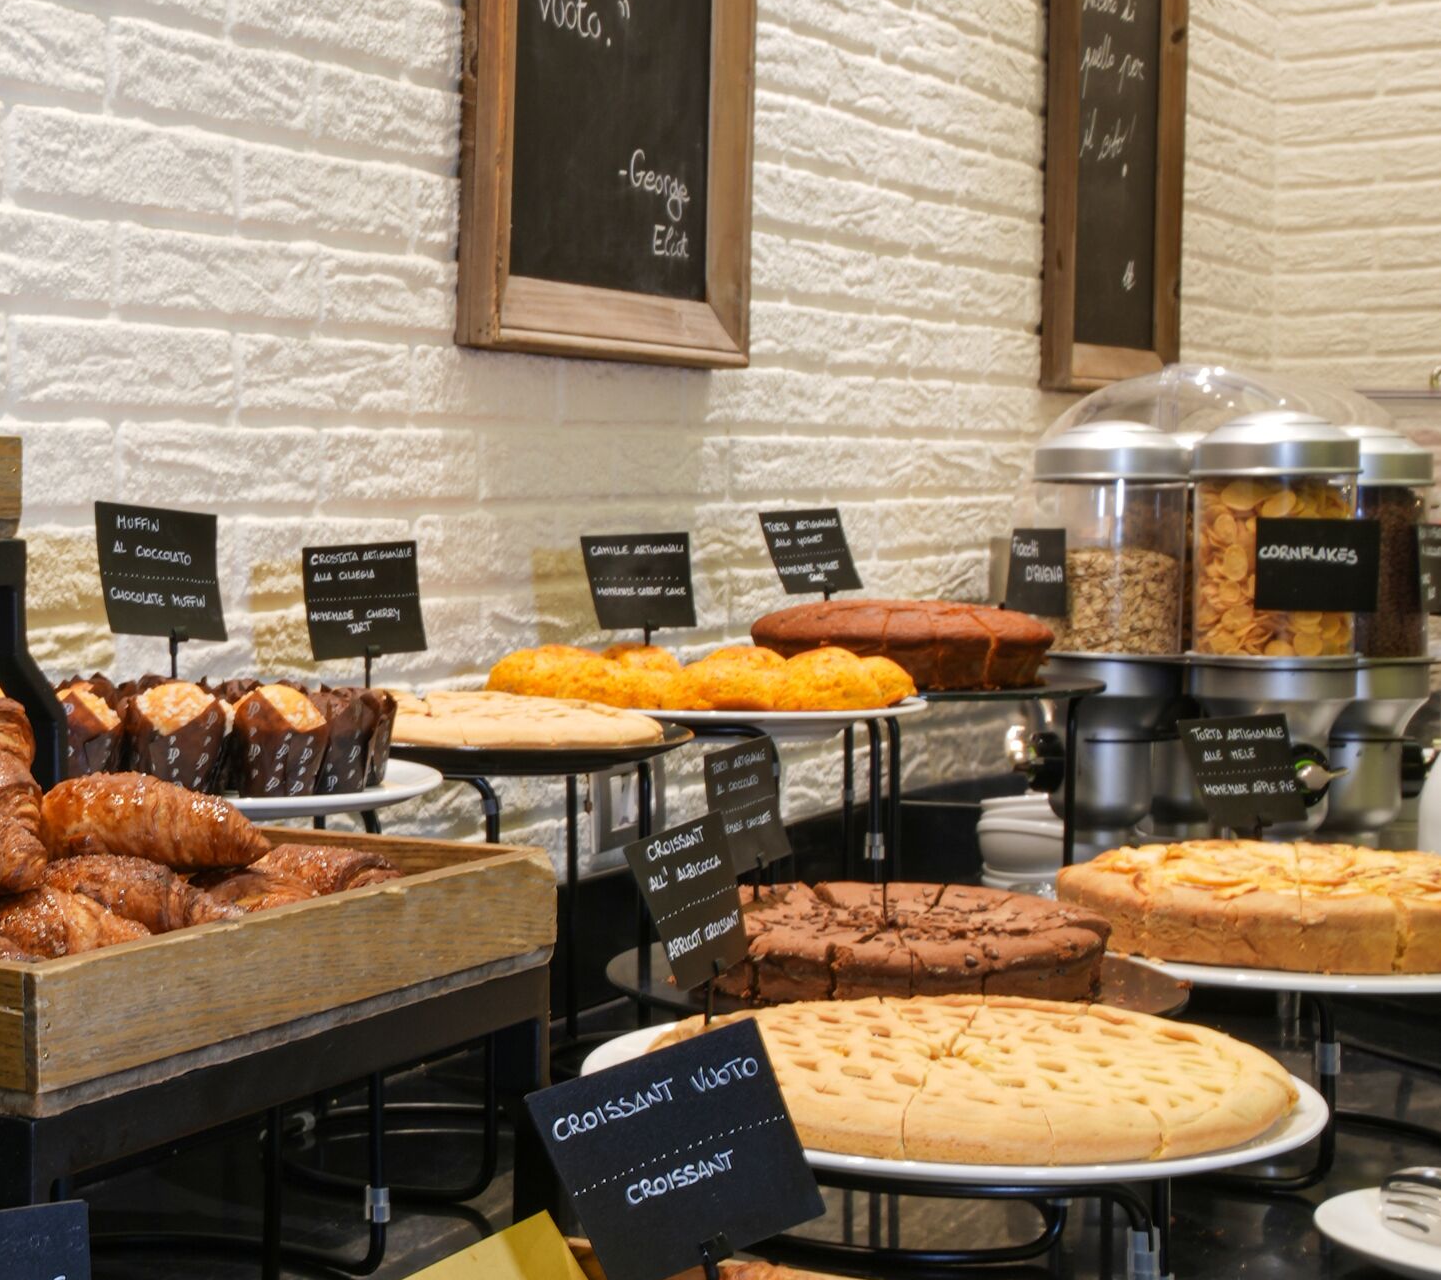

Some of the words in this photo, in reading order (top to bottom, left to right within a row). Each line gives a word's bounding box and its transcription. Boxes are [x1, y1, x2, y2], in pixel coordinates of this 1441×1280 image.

[652, 223, 690, 259] Eliot
[116, 514, 160, 533] MUFFIN
[113, 540, 127, 553] AL
[135, 545, 192, 567] CIOCCOLATO
[310, 550, 359, 566] CROSTATA
[362, 546, 413, 562] ARTIGIANALE
[590, 544, 630, 557] CAMILLE
[1259, 543, 1359, 566] CORNFLAKES
[313, 571, 333, 583] ALLA
[110, 586, 166, 608] CHOCOLATE
[171, 593, 206, 609] MUFFIN
[310, 609, 355, 622] HOMEMADE
[365, 607, 401, 621] CHERRY
[346, 620, 372, 635] TART
[1190, 726, 1224, 741] TORTA
[1202, 749, 1224, 762] ALLE
[1230, 747, 1257, 761] MELE
[1252, 780, 1278, 794] APPLE
[1279, 780, 1297, 793] PIE
[646, 824, 705, 862] CROISSANT
[676, 854, 722, 882] ALBICOCCA
[666, 927, 703, 961] APRICOT
[703, 908, 740, 941] CROISSANT
[551, 1077, 674, 1143] CROISSANT
[690, 1056, 759, 1093] VUOTO
[625, 1149, 735, 1207] CROISSANT
